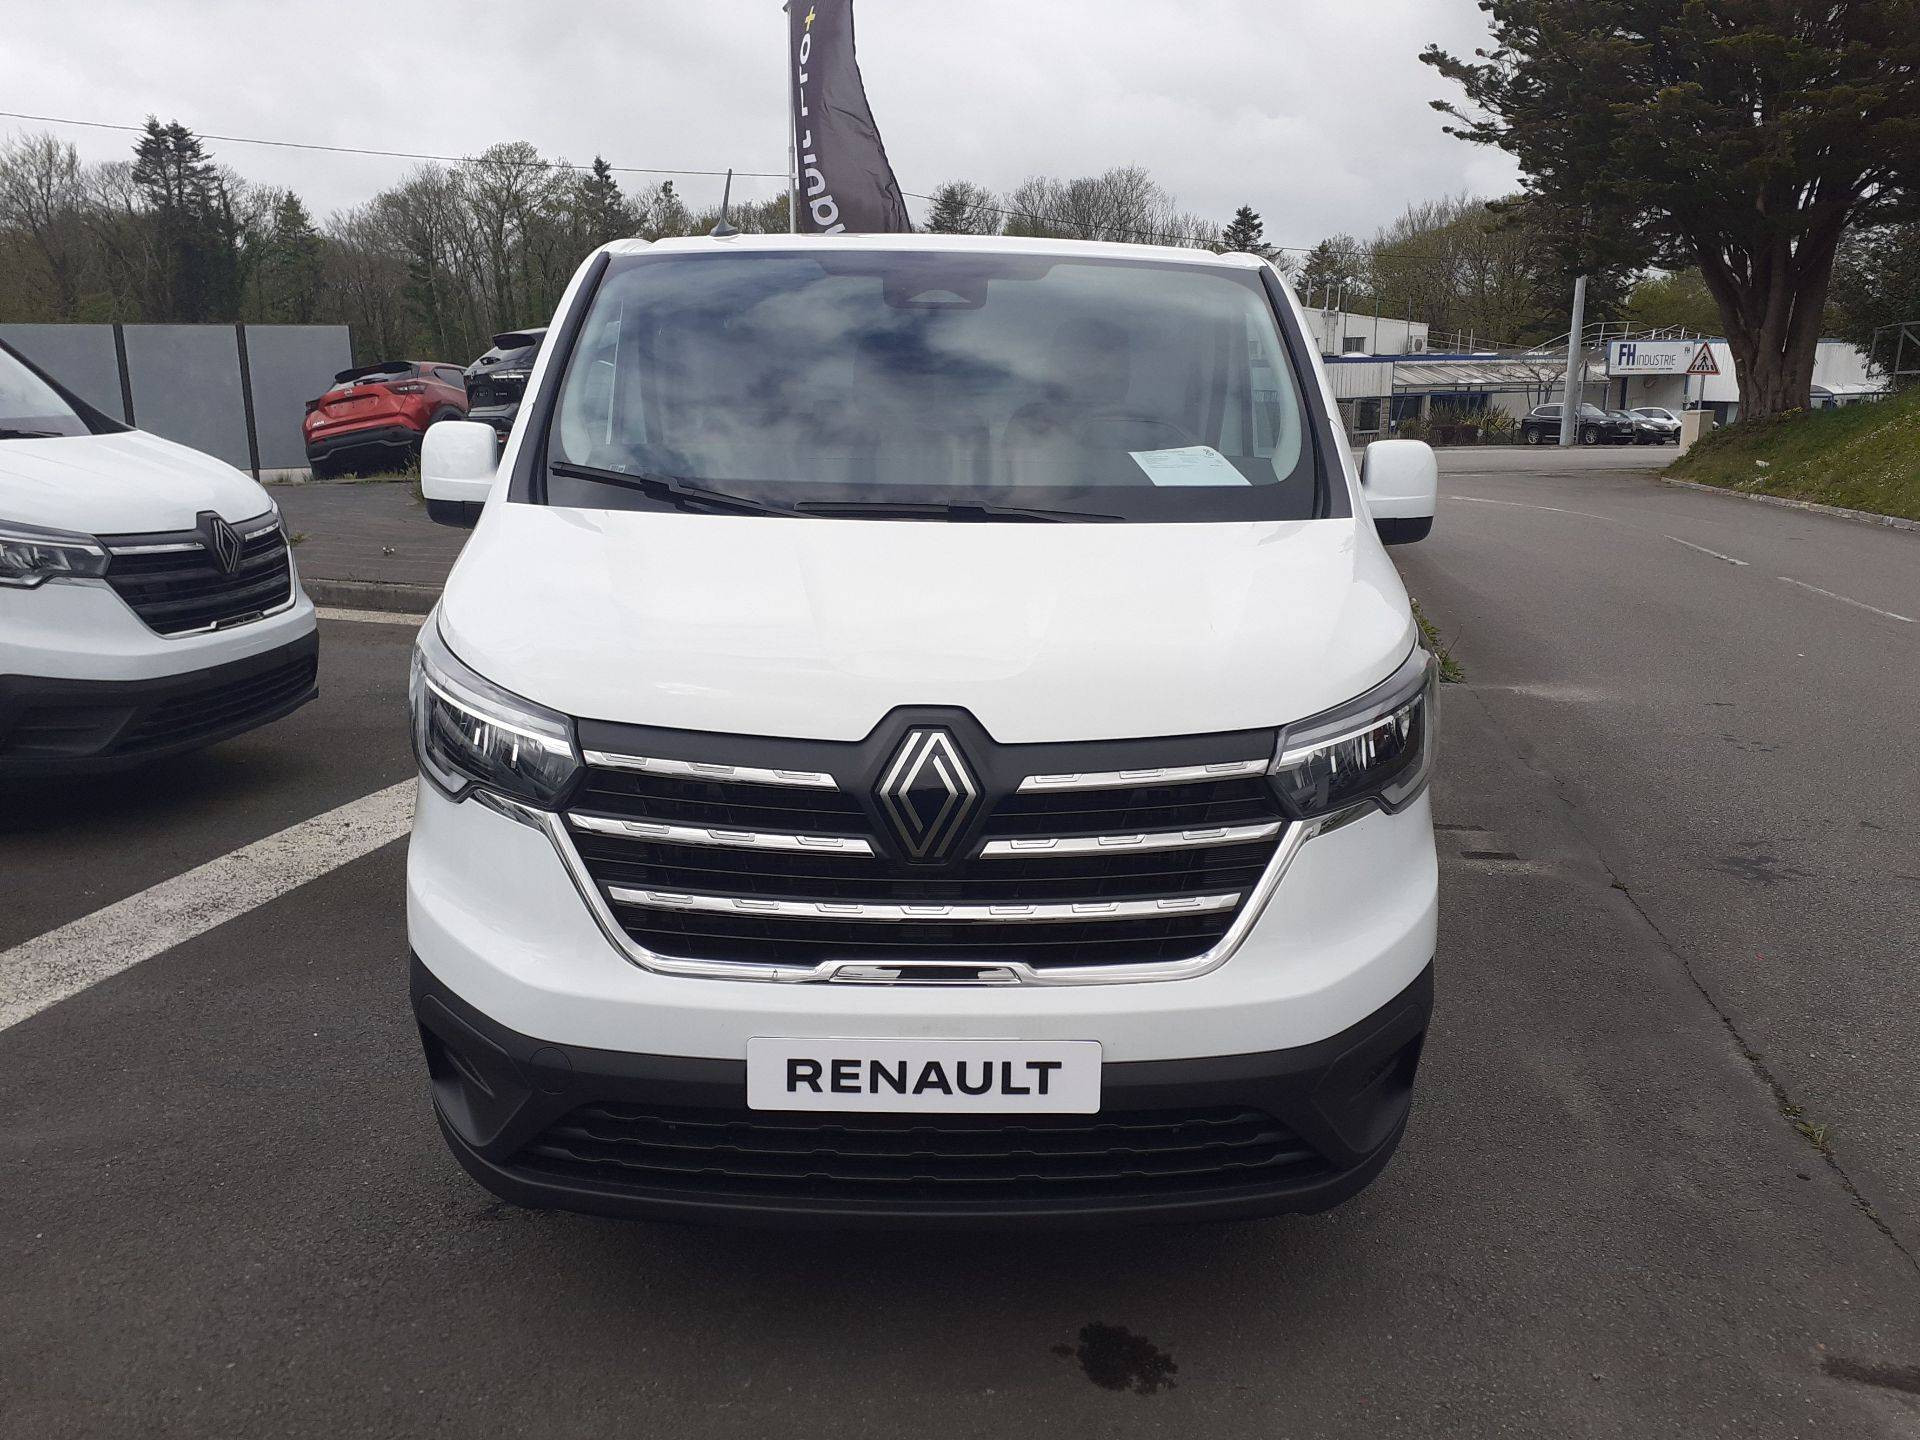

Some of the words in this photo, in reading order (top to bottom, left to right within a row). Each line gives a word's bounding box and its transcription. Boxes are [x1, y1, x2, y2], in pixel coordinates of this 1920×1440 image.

[1618, 344, 1637, 366] FH
[1636, 354, 1677, 366] INDUSTRIE
[787, 1058, 1063, 1096] RENAULT
